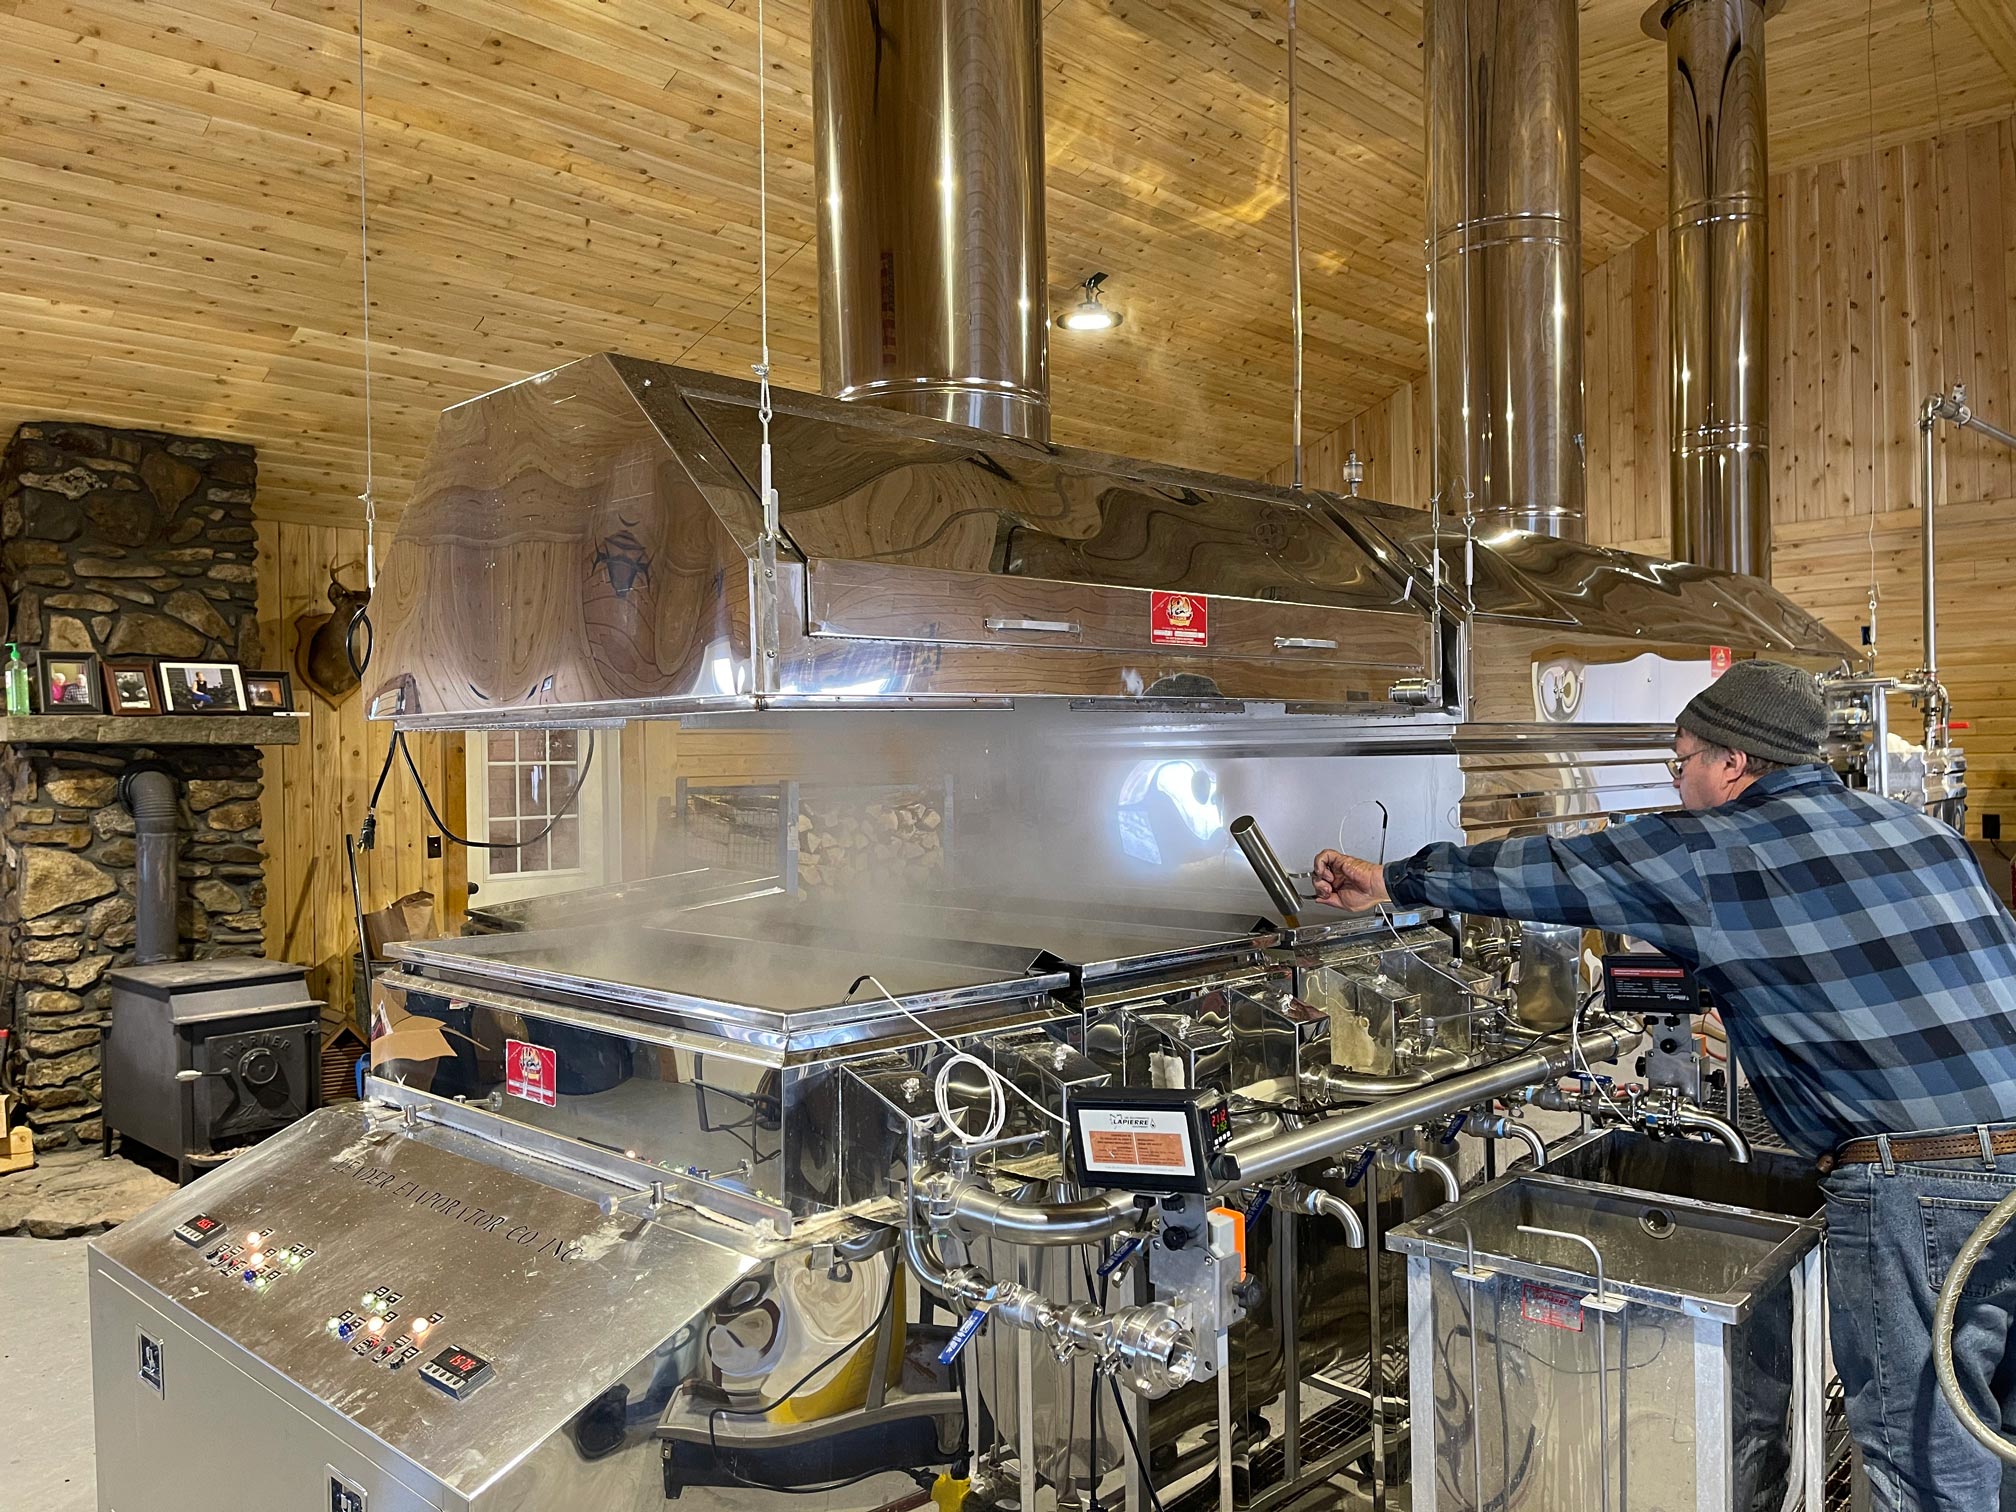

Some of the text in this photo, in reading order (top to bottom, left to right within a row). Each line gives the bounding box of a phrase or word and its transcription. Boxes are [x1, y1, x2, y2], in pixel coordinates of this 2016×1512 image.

[222, 1033, 292, 1060] WARNER
[332, 1157, 396, 1189] LEADER
[392, 1181, 506, 1233] EVAPORATOR
